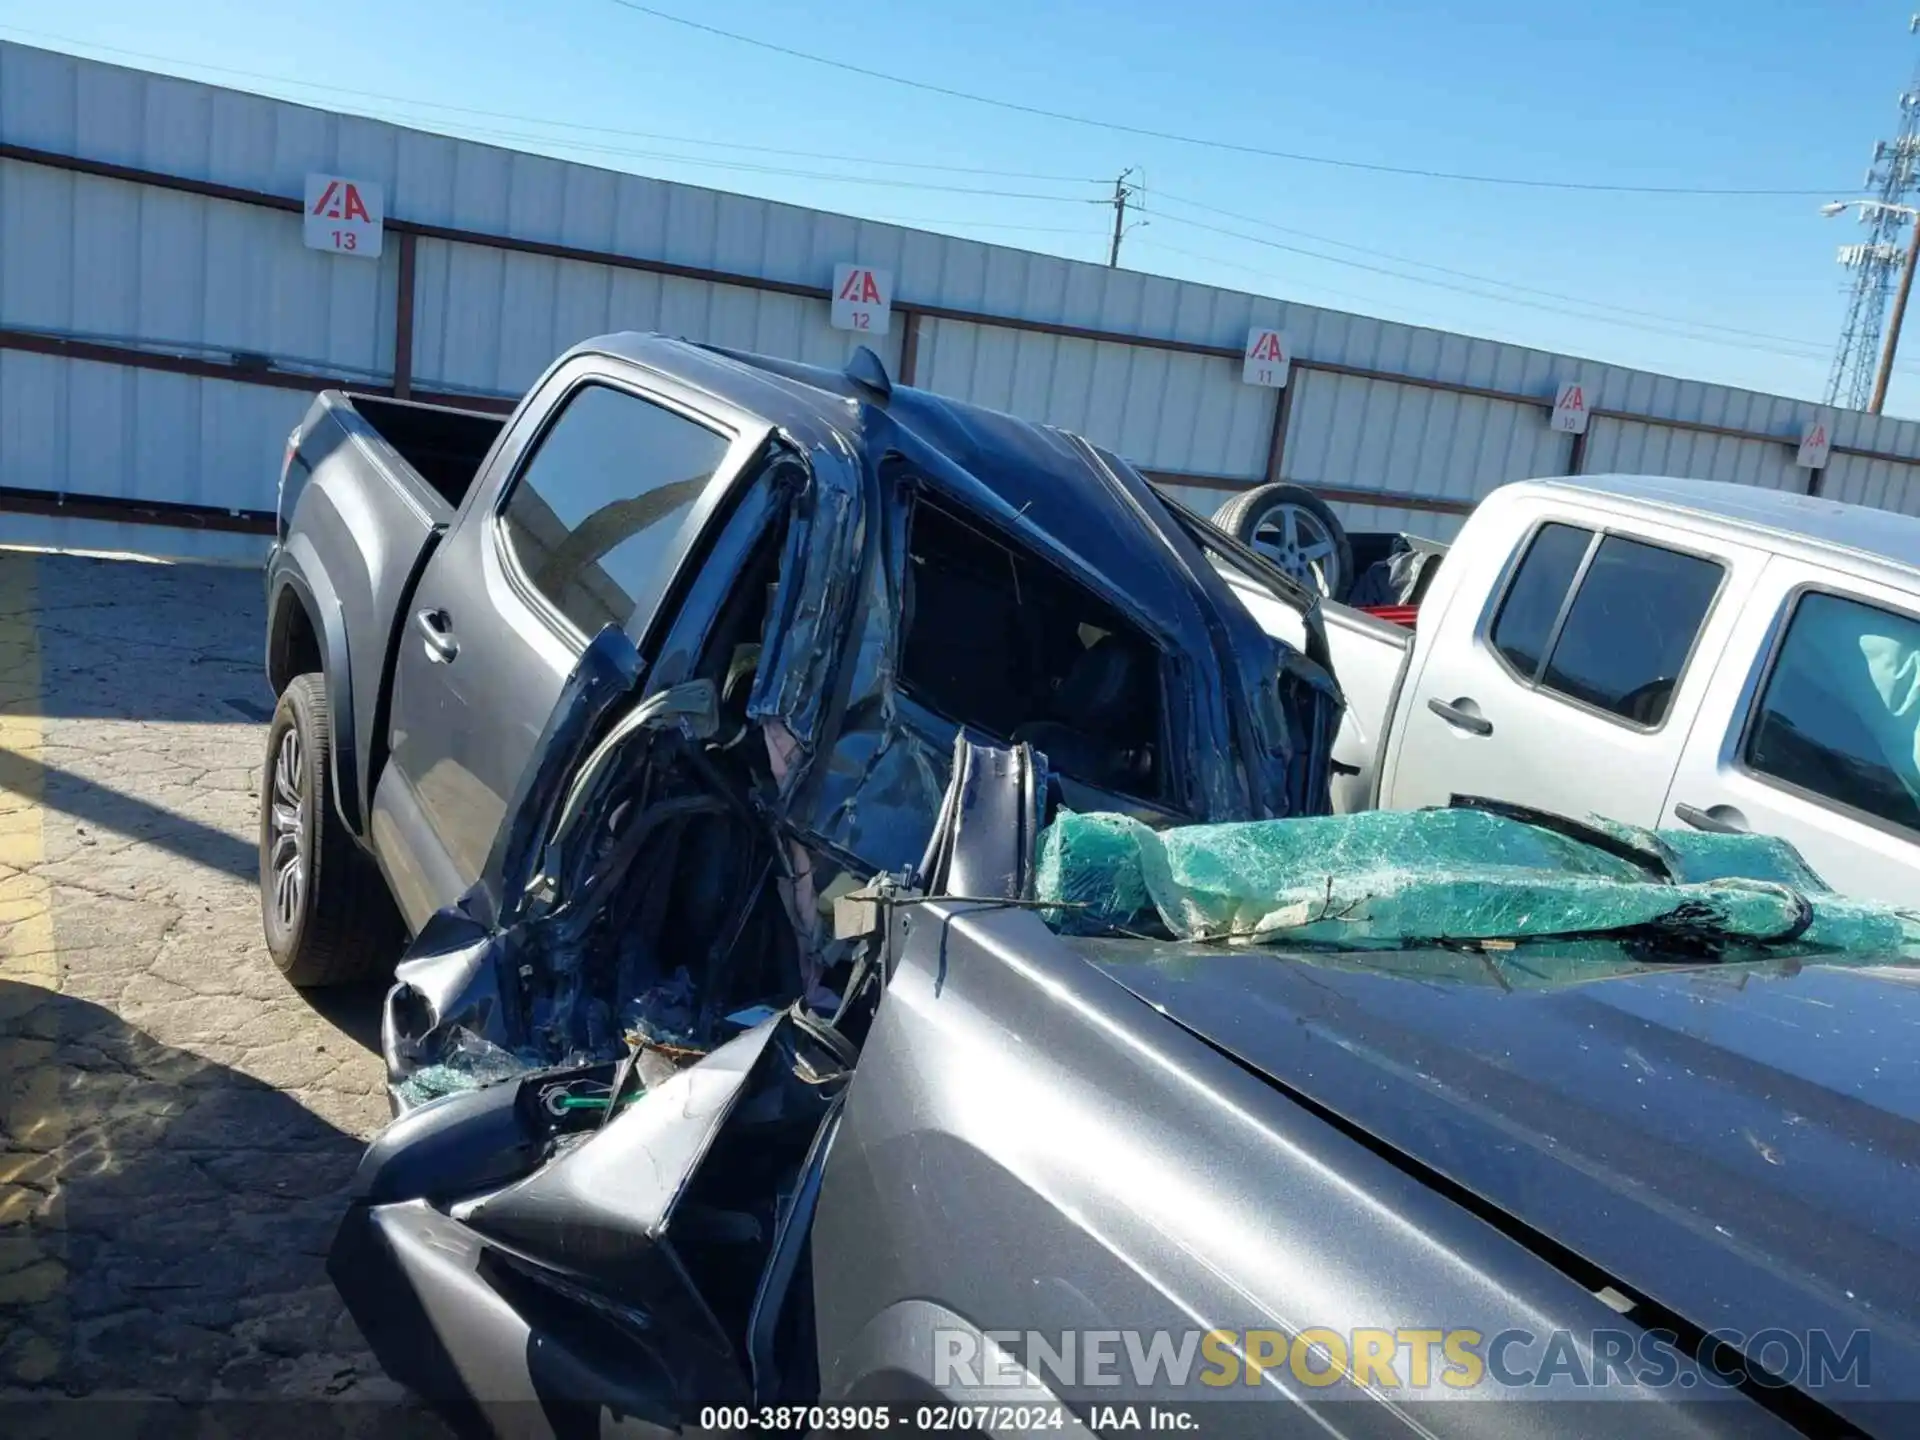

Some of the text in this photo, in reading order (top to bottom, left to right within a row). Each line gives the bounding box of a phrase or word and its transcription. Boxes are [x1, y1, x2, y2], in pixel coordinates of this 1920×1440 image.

[331, 230, 357, 250] 13
[851, 312, 870, 329] 12
[1257, 370, 1272, 383] 11
